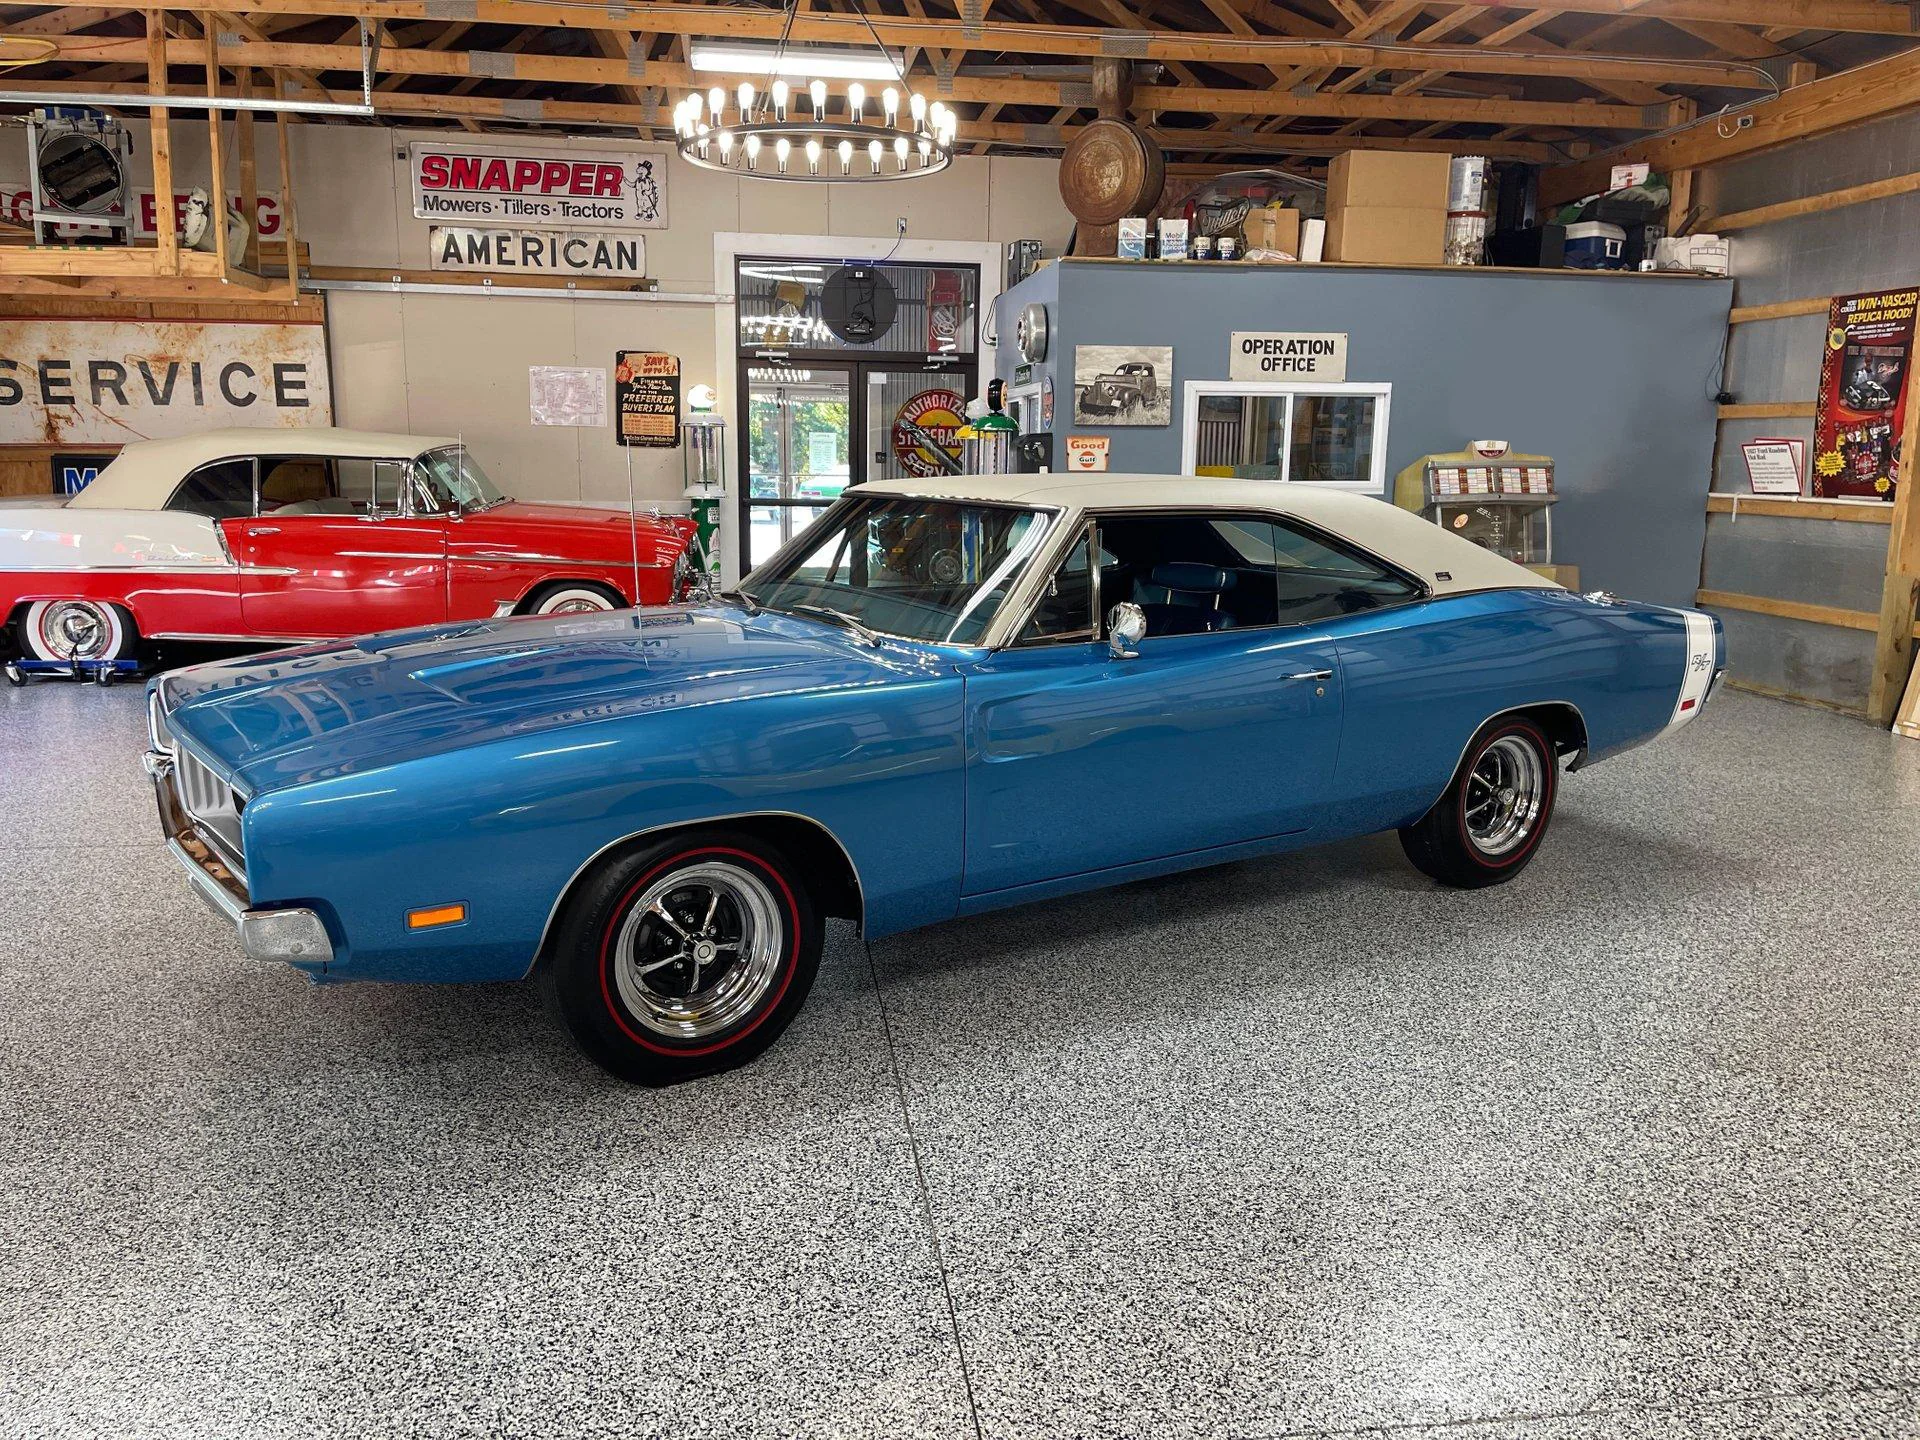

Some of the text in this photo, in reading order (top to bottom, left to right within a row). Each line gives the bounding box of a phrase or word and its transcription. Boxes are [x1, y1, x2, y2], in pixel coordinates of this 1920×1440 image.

[420, 155, 624, 197] SNAPPER
[422, 194, 624, 220] Mowers Tillers Tractors
[1165, 231, 1184, 239] Mobil
[441, 233, 638, 271] AMERICAN
[1857, 297, 1878, 310] WIN
[1881, 293, 1918, 307] NASCAR
[1847, 308, 1913, 323] REPLICA HOOD!
[1242, 339, 1335, 357] OPERATION
[1260, 357, 1316, 373] OFFICE
[0, 359, 310, 408] SERVICE
[622, 393, 675, 404] PREFERRED
[622, 402, 676, 413] BUYERS PLAN
[904, 394, 966, 422] AUTHORIZE
[1070, 440, 1105, 449] Good
[1691, 653, 1711, 672] R/T
